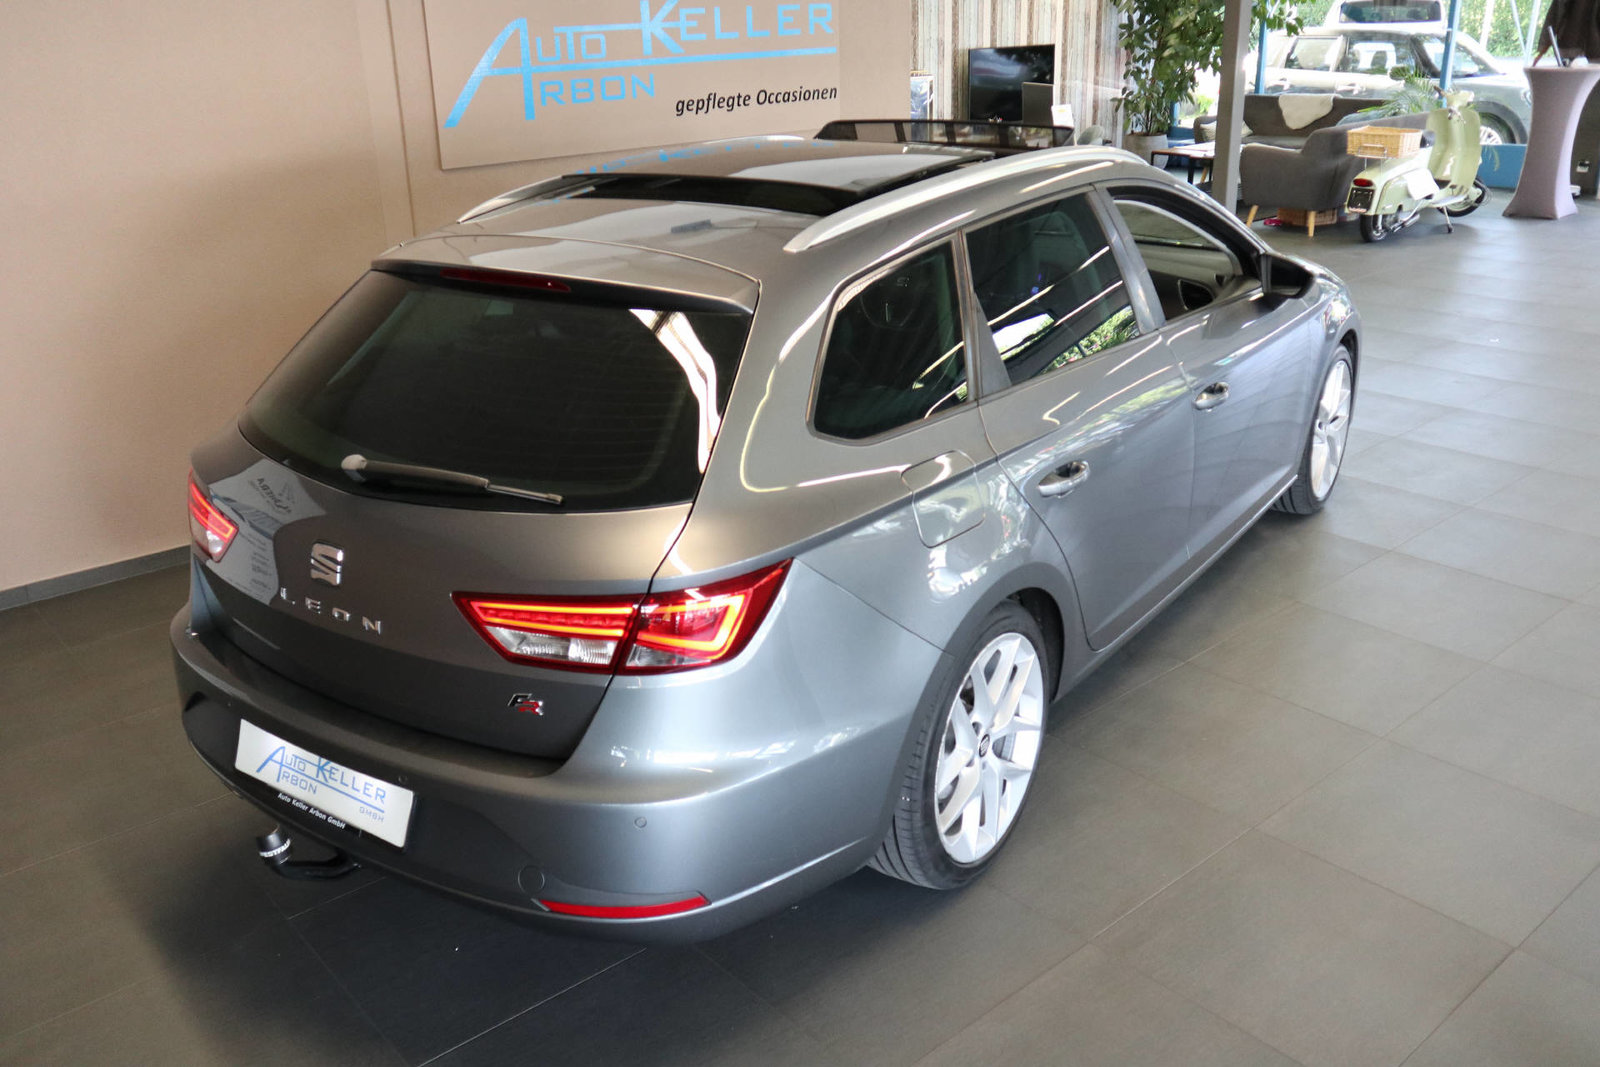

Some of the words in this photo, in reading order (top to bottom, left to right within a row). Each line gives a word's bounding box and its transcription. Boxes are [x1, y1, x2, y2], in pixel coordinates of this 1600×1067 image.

[640, 0, 835, 55] KELLER
[675, 92, 752, 117] gepflegte
[755, 85, 838, 107] Occasionen
[280, 587, 382, 635] LEON
[316, 756, 387, 804] KELLER
[277, 792, 292, 804] Auto
[292, 799, 309, 812] Keller
[309, 807, 327, 821] Arbon
[327, 815, 347, 830] GmbH
